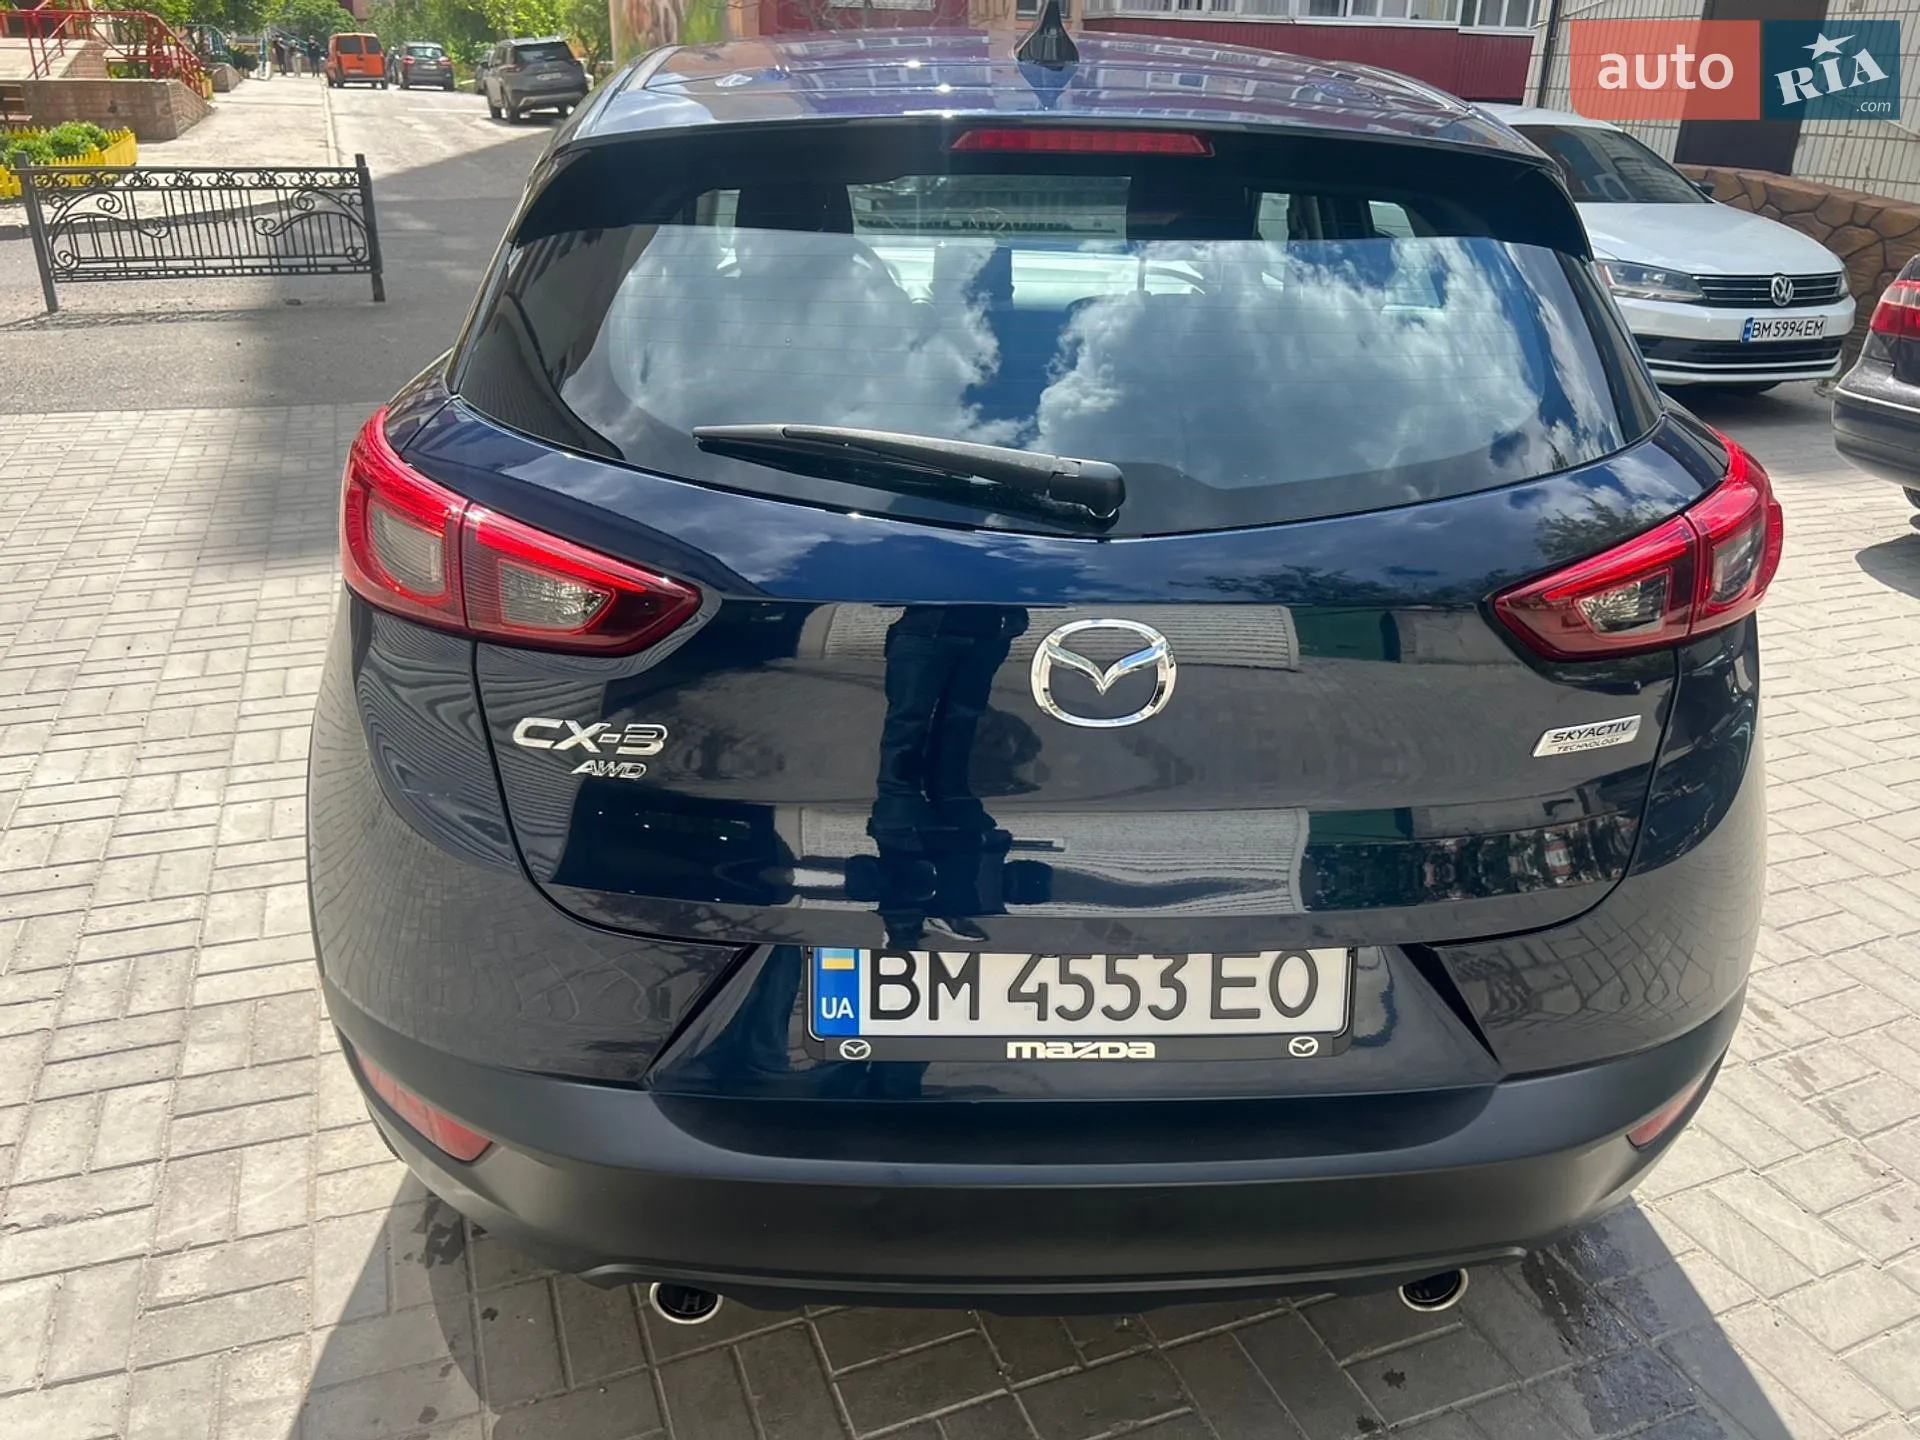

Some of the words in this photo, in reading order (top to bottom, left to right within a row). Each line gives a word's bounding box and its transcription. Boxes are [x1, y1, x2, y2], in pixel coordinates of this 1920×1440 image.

[512, 717, 668, 756] CX-3
[1550, 719, 1633, 743] SKYACTIV
[1556, 737, 1622, 752] TECHNOLOGY
[570, 759, 647, 779] AWD
[870, 950, 981, 1021] BM
[1007, 953, 1187, 1021] 4553
[1210, 949, 1319, 1019] EO
[821, 997, 854, 1020] UA
